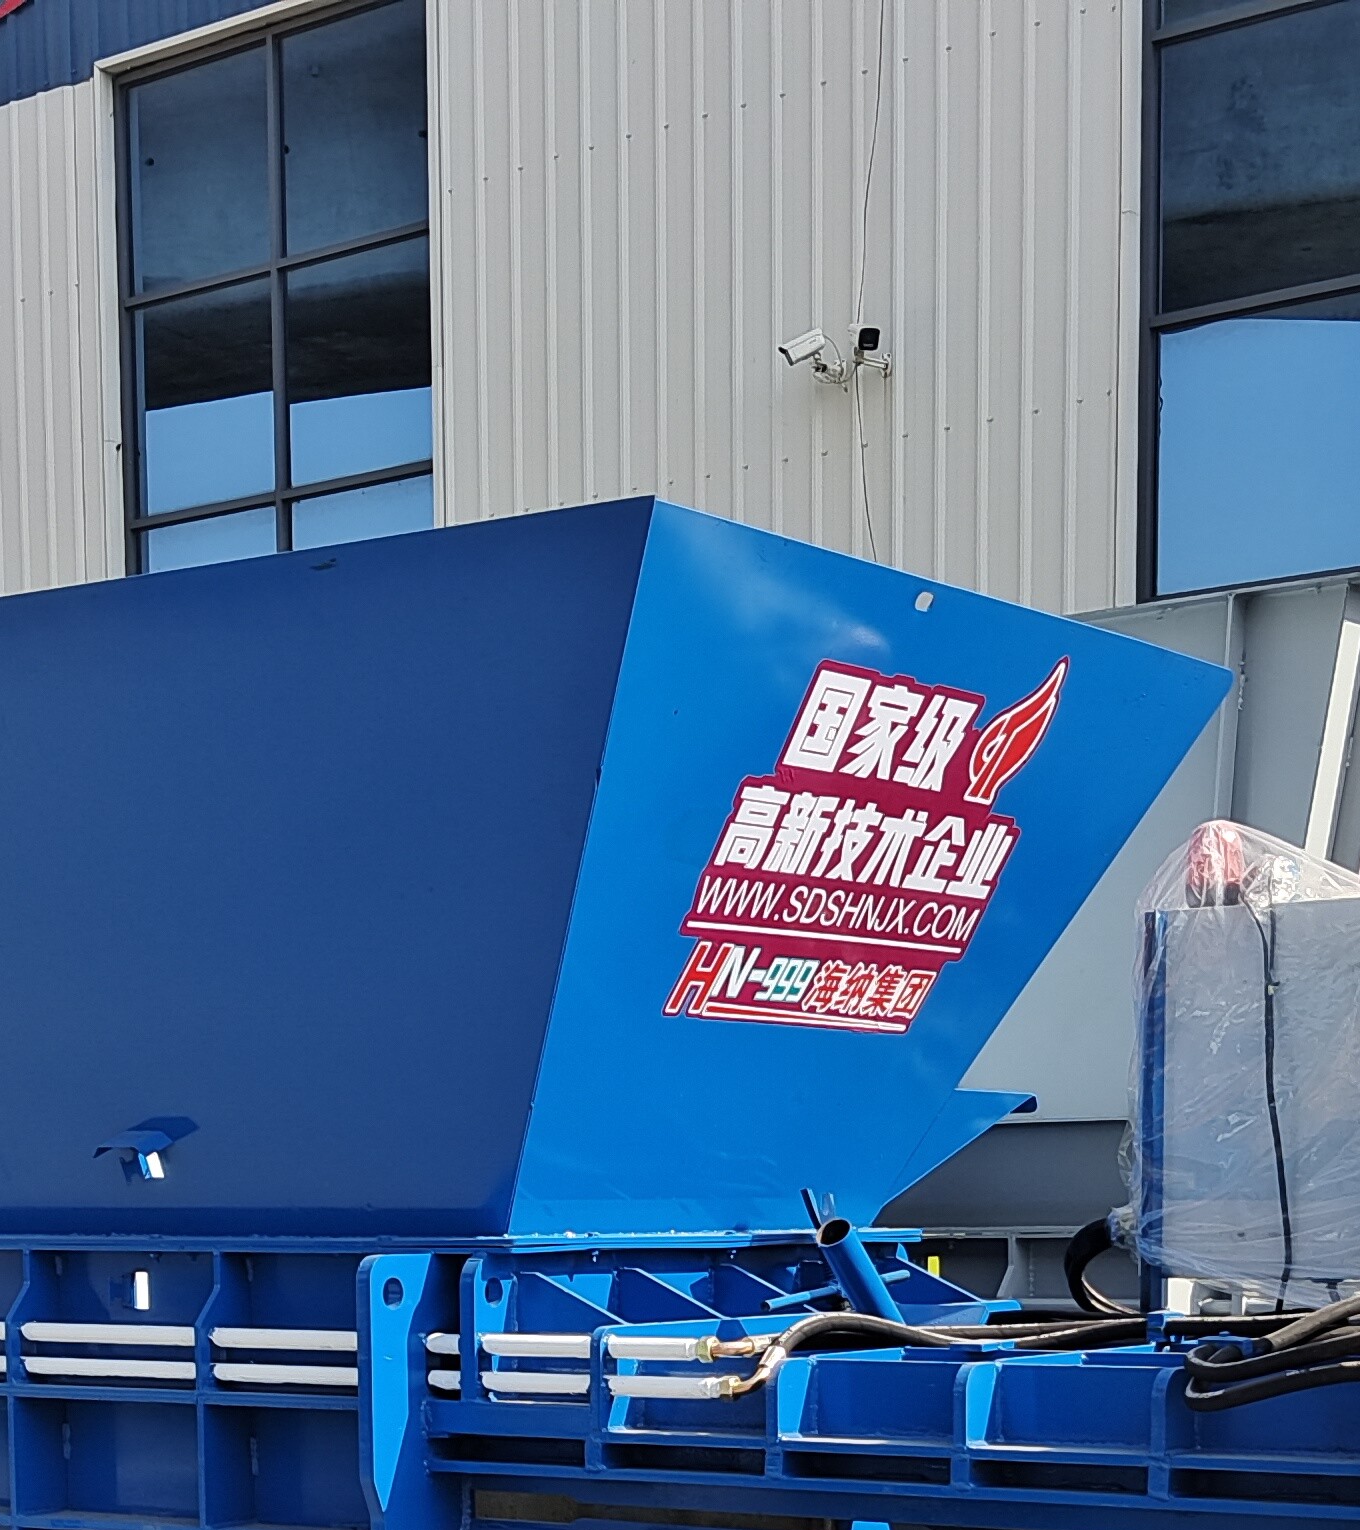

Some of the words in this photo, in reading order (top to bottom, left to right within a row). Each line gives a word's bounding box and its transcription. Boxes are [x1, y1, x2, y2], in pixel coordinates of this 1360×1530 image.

[782, 669, 980, 792] 国家级
[714, 784, 1014, 900] 高新技术企业
[696, 875, 981, 943] WWW.SDSHNJX.COM
